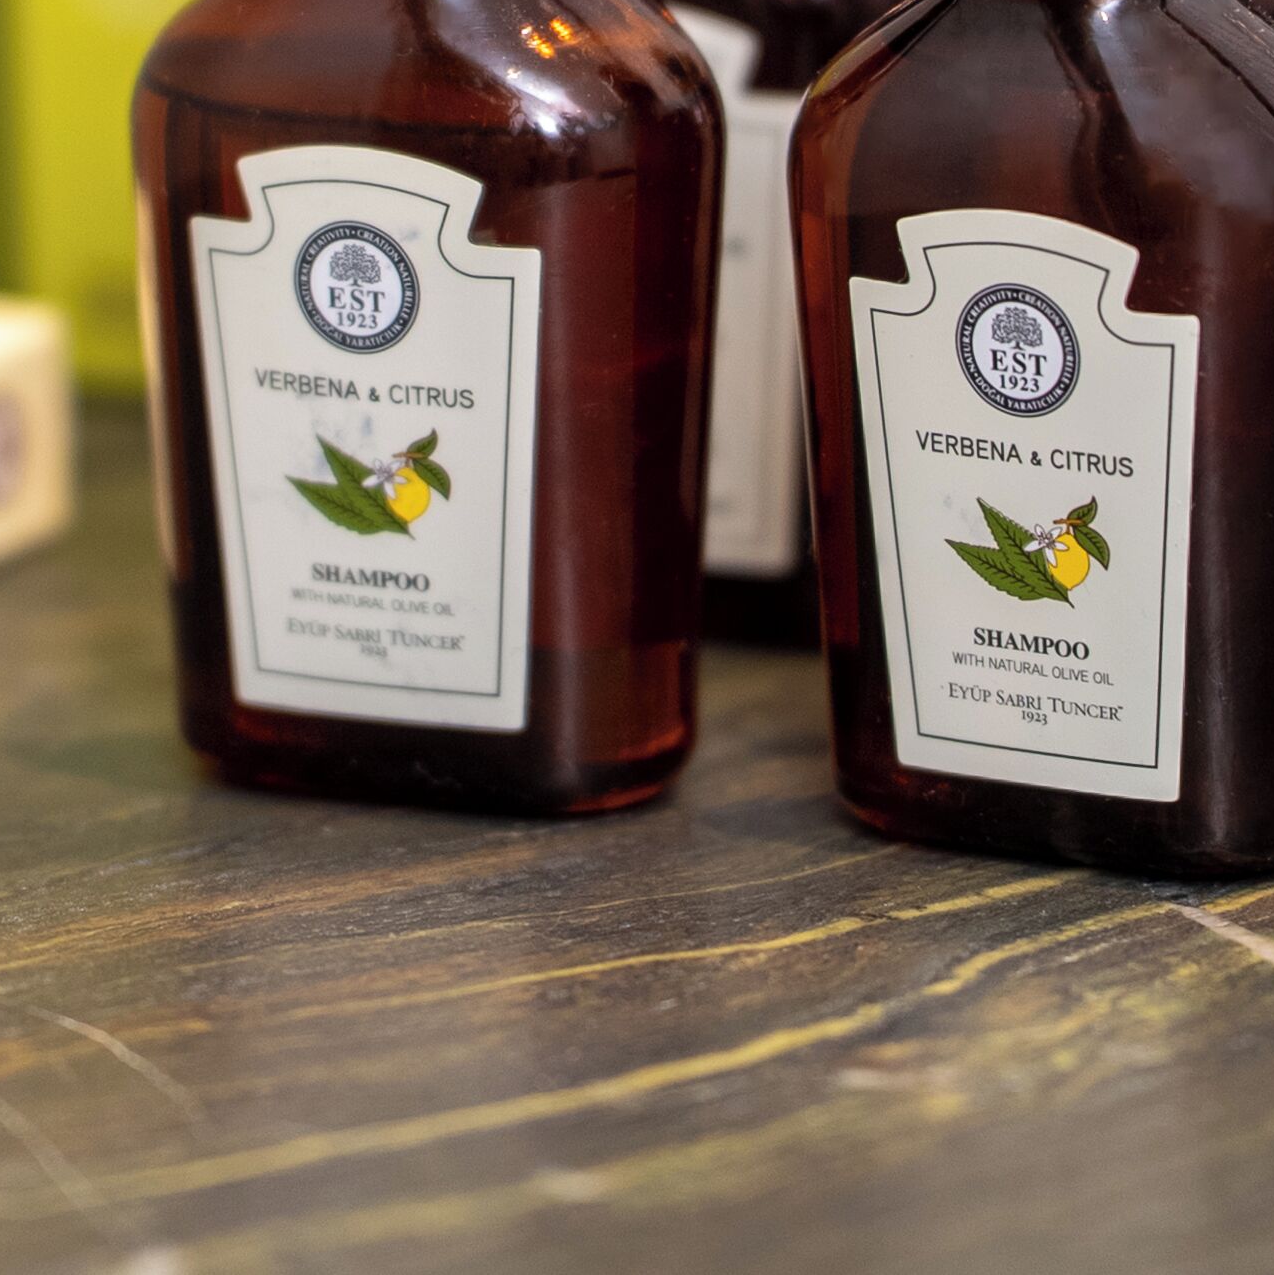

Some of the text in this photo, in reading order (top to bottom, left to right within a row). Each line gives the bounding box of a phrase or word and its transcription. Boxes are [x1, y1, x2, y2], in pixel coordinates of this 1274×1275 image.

[328, 286, 386, 313] EST
[336, 312, 378, 329] 1923
[990, 348, 1047, 377] EST
[255, 367, 475, 410] VERBENA & CITRUS
[999, 374, 1040, 393] 1923
[916, 430, 1134, 477] VERBENA & CITRUS
[311, 563, 430, 593] SHAMPOO
[291, 587, 455, 616] WITH NATURAL OLIVE OIL
[973, 627, 1090, 660] SHAMPOO
[952, 651, 1114, 686] WITH NATURAL OLIVE OIL
[948, 682, 992, 703] EYÜP
[1022, 710, 1048, 726] 1923
